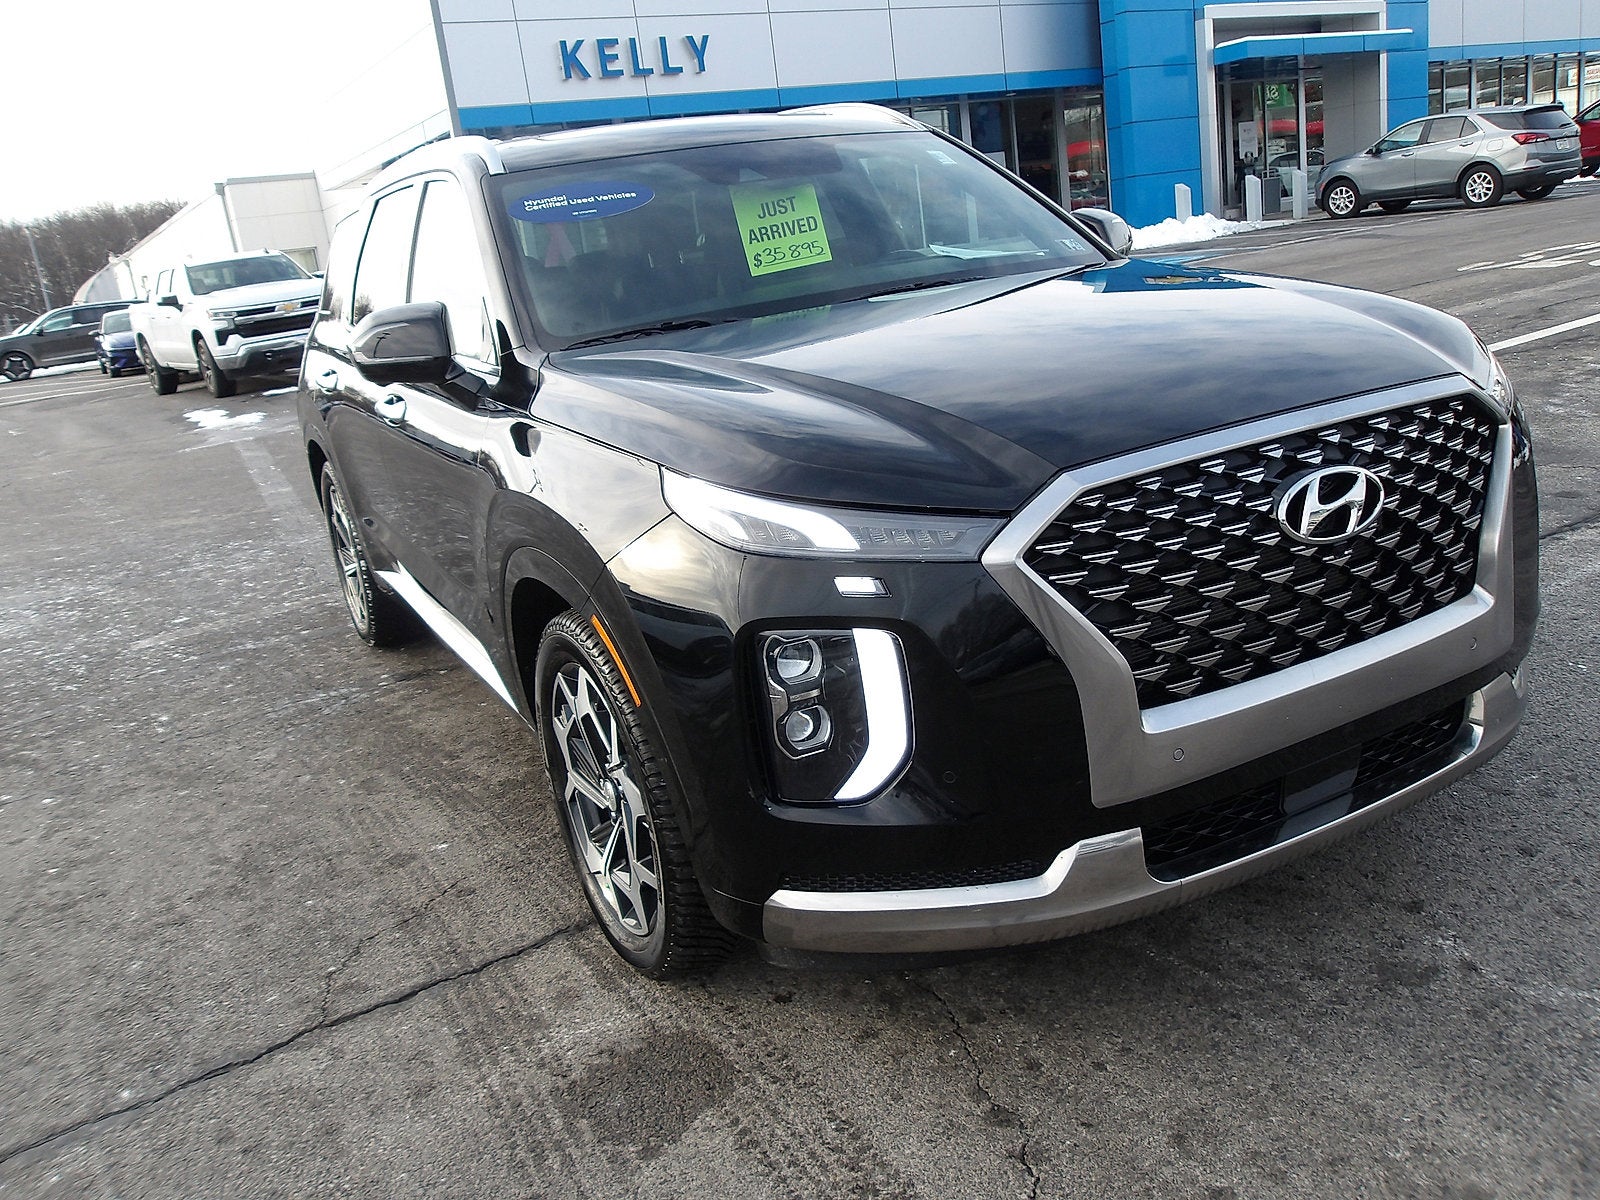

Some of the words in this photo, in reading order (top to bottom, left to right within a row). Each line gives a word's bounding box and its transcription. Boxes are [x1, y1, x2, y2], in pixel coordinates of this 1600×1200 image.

[558, 35, 710, 80] KELLY
[524, 195, 567, 206] Hyundai
[525, 200, 568, 212] Certified
[569, 196, 595, 205] Used
[595, 192, 637, 202] Vehicles
[758, 196, 796, 219] JUST
[748, 216, 818, 245] ARRIVED
